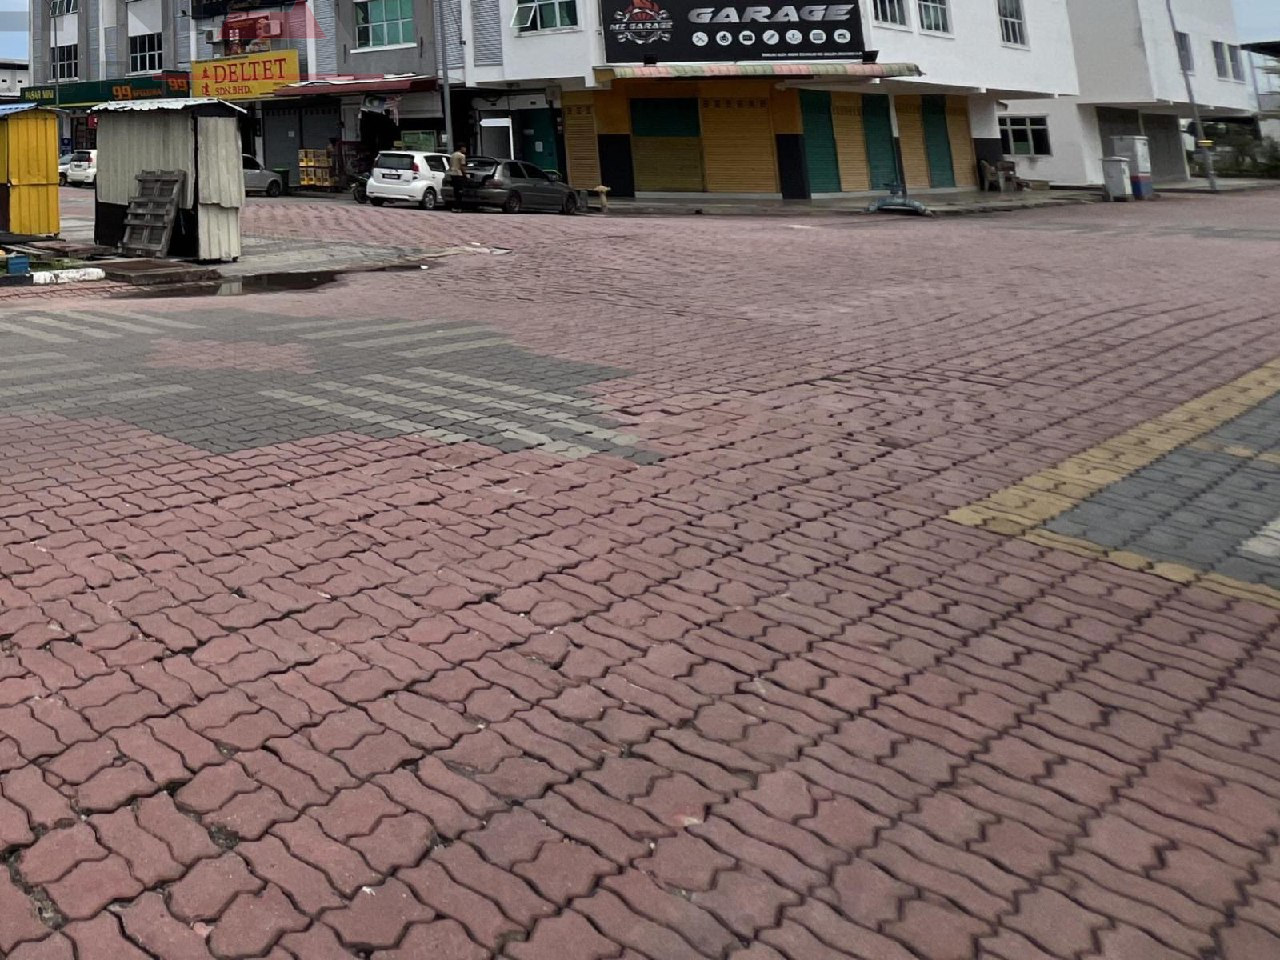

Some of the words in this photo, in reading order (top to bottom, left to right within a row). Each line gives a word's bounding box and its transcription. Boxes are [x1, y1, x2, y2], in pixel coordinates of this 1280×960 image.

[687, 4, 855, 24] GARAGE
[629, 21, 673, 30] GARAGE
[213, 58, 287, 83] DELTET
[167, 78, 188, 91] 99
[112, 85, 133, 100] 99
